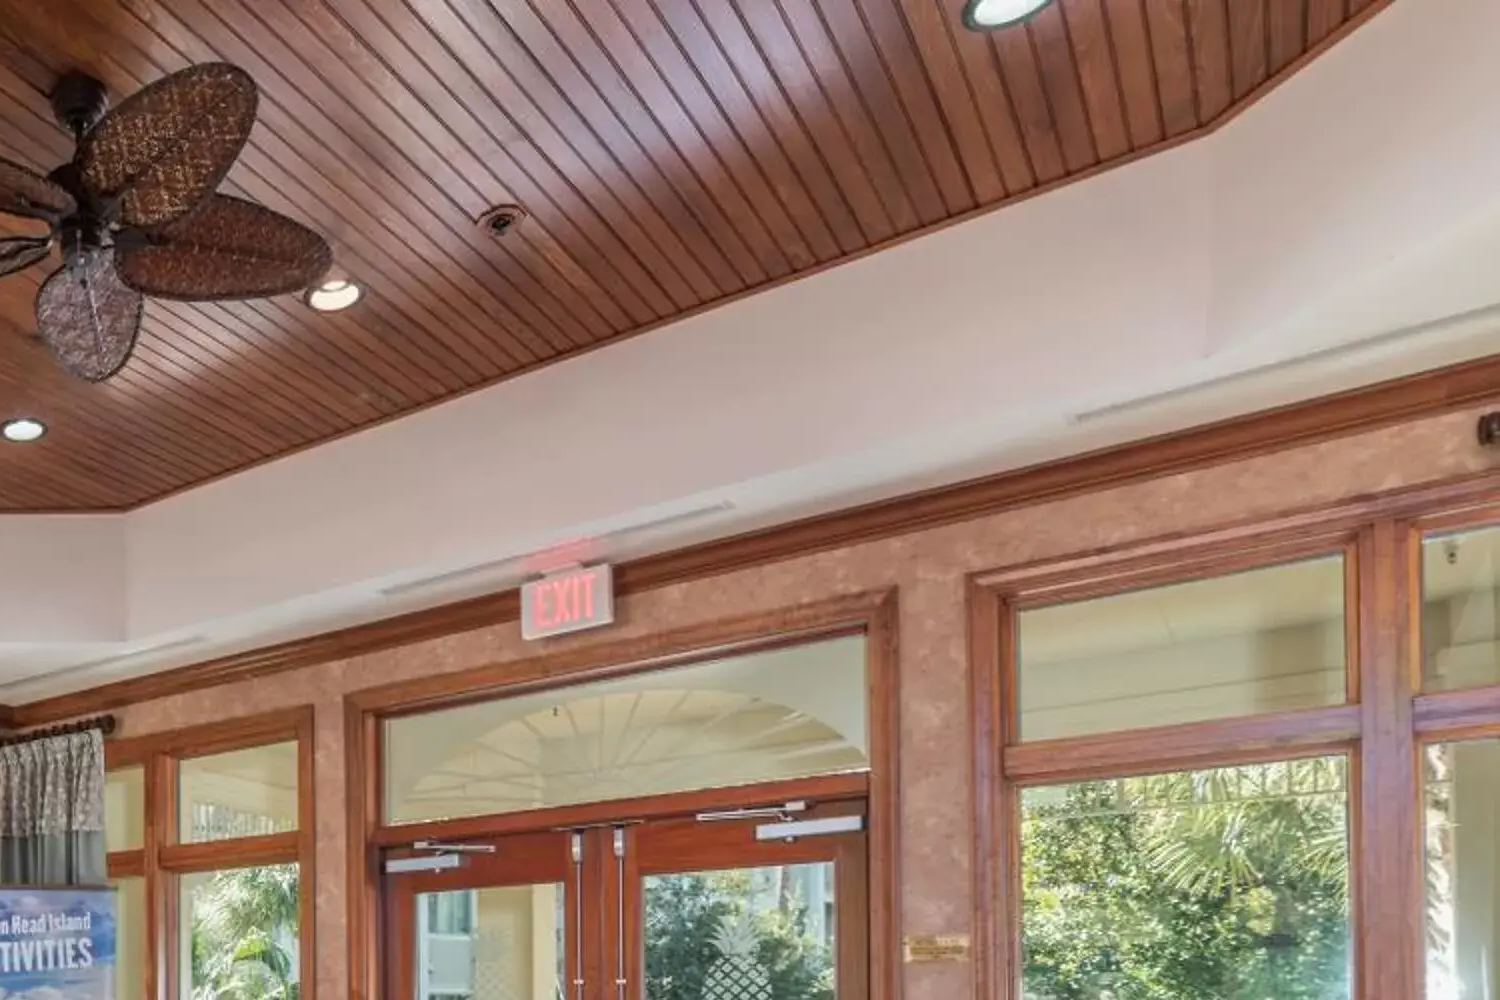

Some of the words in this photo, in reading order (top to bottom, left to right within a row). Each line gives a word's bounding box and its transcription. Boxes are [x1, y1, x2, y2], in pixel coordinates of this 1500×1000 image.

[532, 573, 596, 629] EXIT
[11, 913, 47, 935] Head
[48, 911, 91, 933] Island
